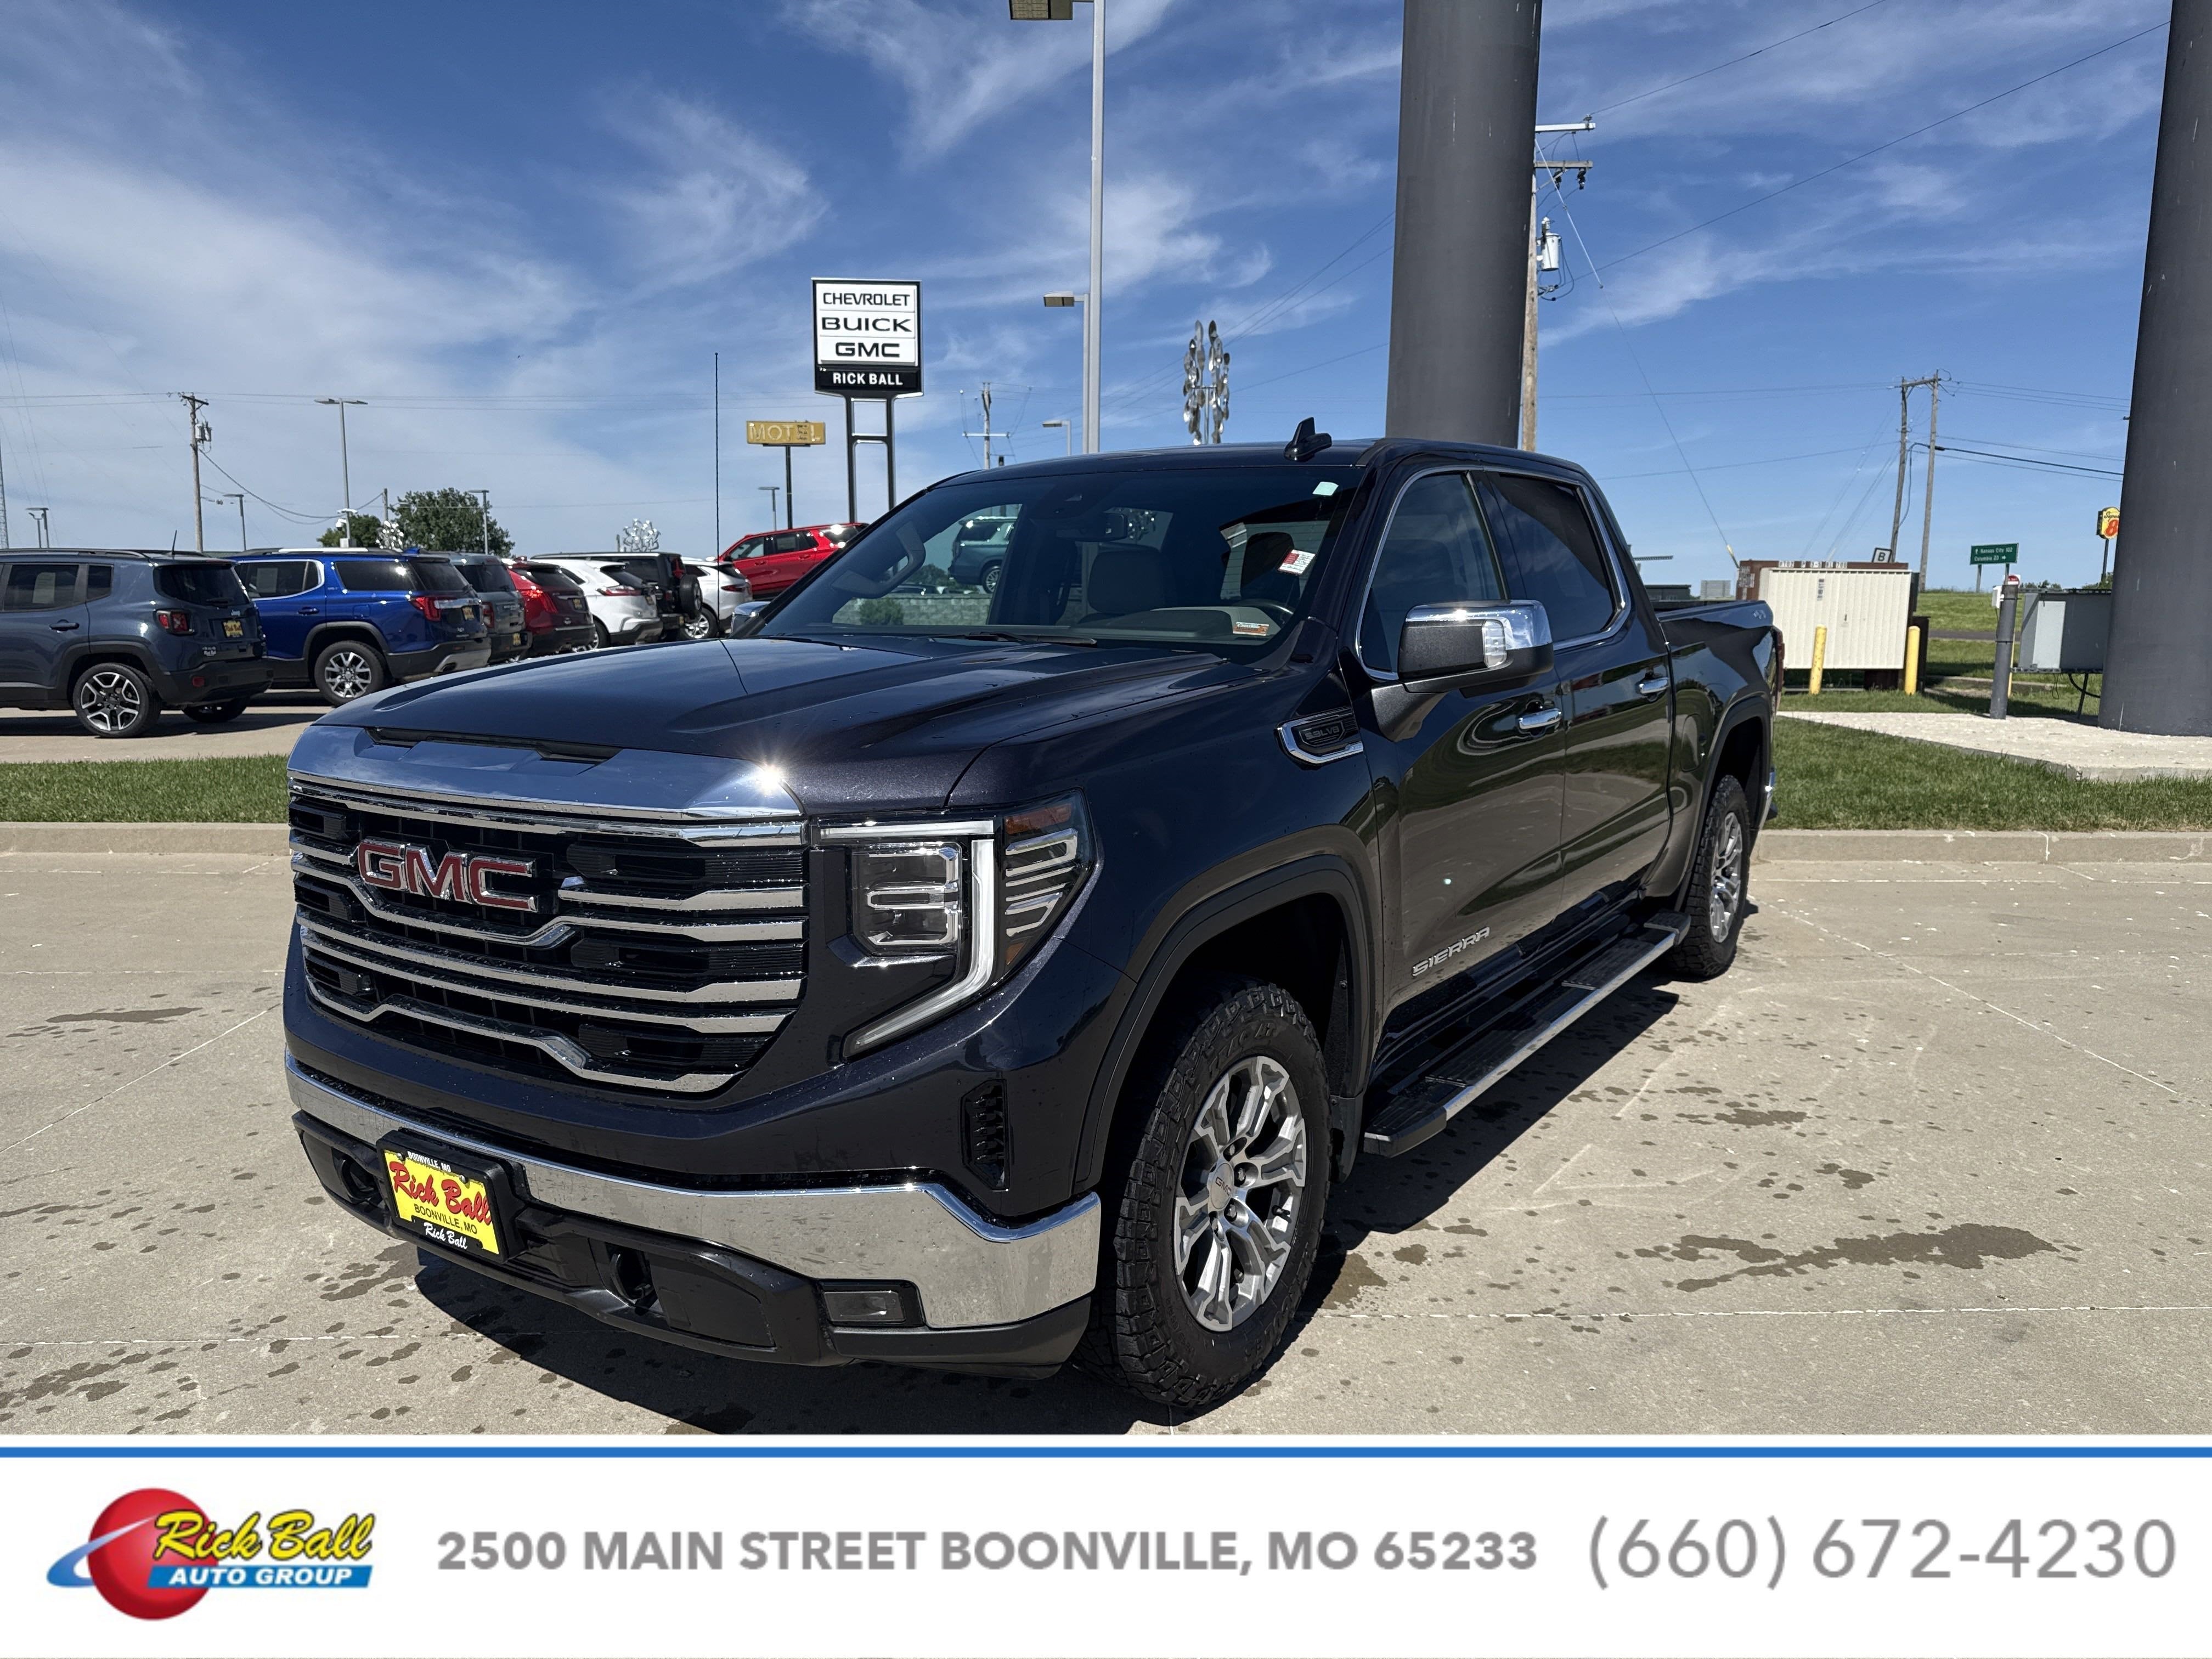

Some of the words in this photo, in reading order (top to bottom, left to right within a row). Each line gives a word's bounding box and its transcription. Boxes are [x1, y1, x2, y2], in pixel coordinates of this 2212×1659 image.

[823, 292, 910, 306] CHEVROLET
[822, 317, 912, 332] BUICK
[836, 342, 900, 358] GMC
[833, 373, 866, 384] RICK
[869, 374, 903, 385] BALL
[1877, 552, 1886, 561] B
[357, 838, 539, 912] GMC
[1412, 926, 1490, 977] SIERRA
[407, 1151, 441, 1170] BOONVILLE,
[441, 1163, 452, 1173] MO
[389, 1161, 439, 1206] Rick
[441, 1179, 492, 1226] Ball
[1215, 1176, 1231, 1197] GMC
[414, 1203, 463, 1231] BOONVILLE,
[464, 1223, 477, 1234] MO
[424, 1222, 445, 1242] Rick
[447, 1230, 467, 1249] Ball
